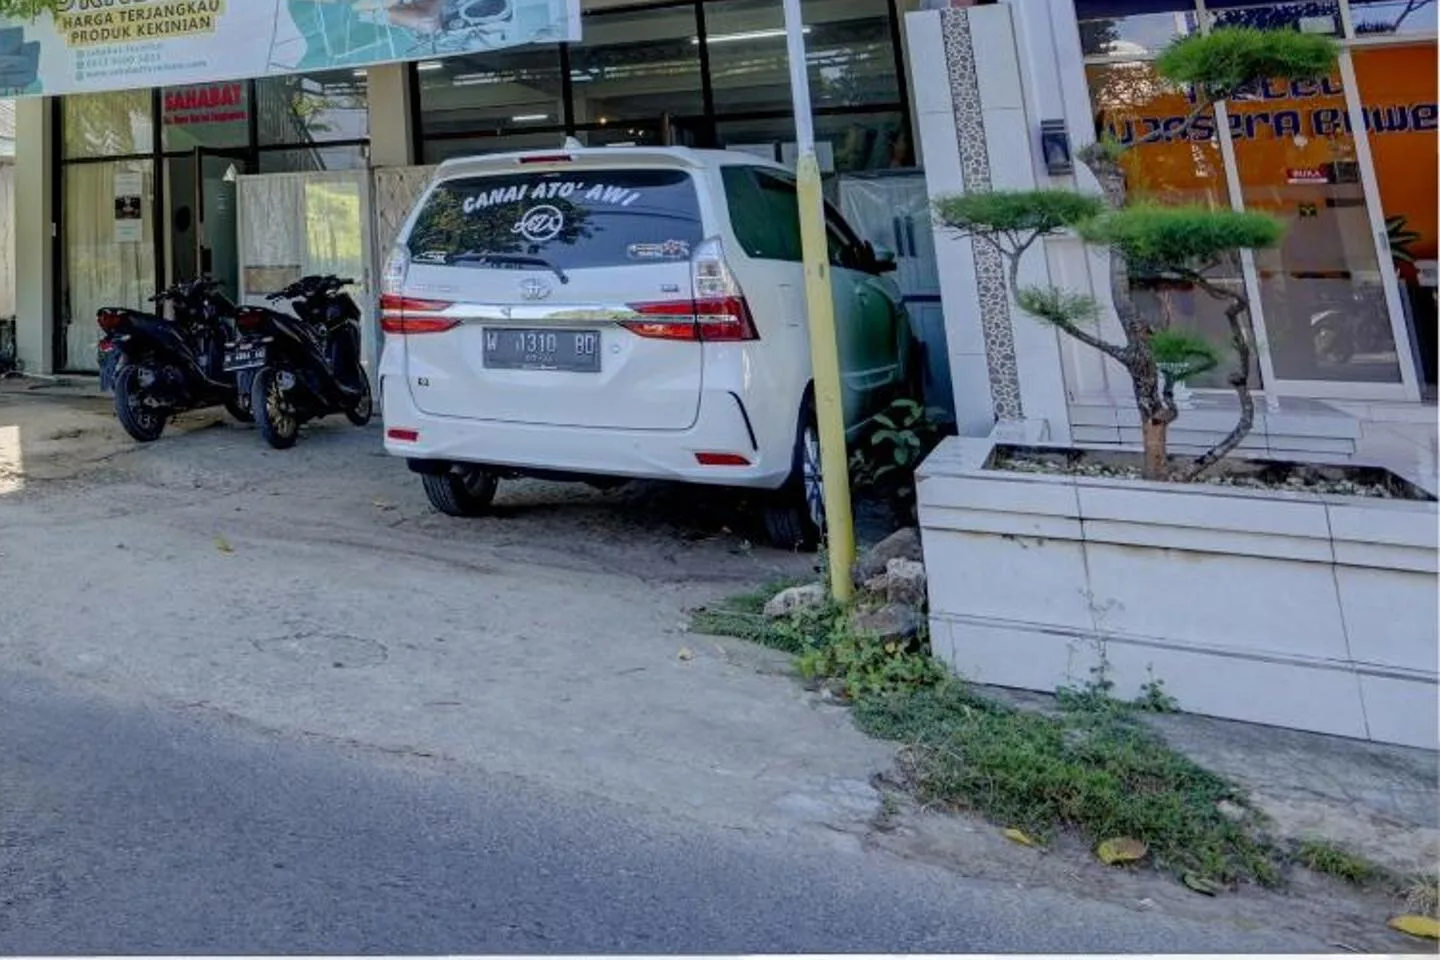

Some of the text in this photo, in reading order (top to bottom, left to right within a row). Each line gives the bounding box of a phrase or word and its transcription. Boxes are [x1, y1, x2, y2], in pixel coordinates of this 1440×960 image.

[63, 12, 114, 30] HARGA
[70, 16, 211, 44] PRODUK KEKINIAN
